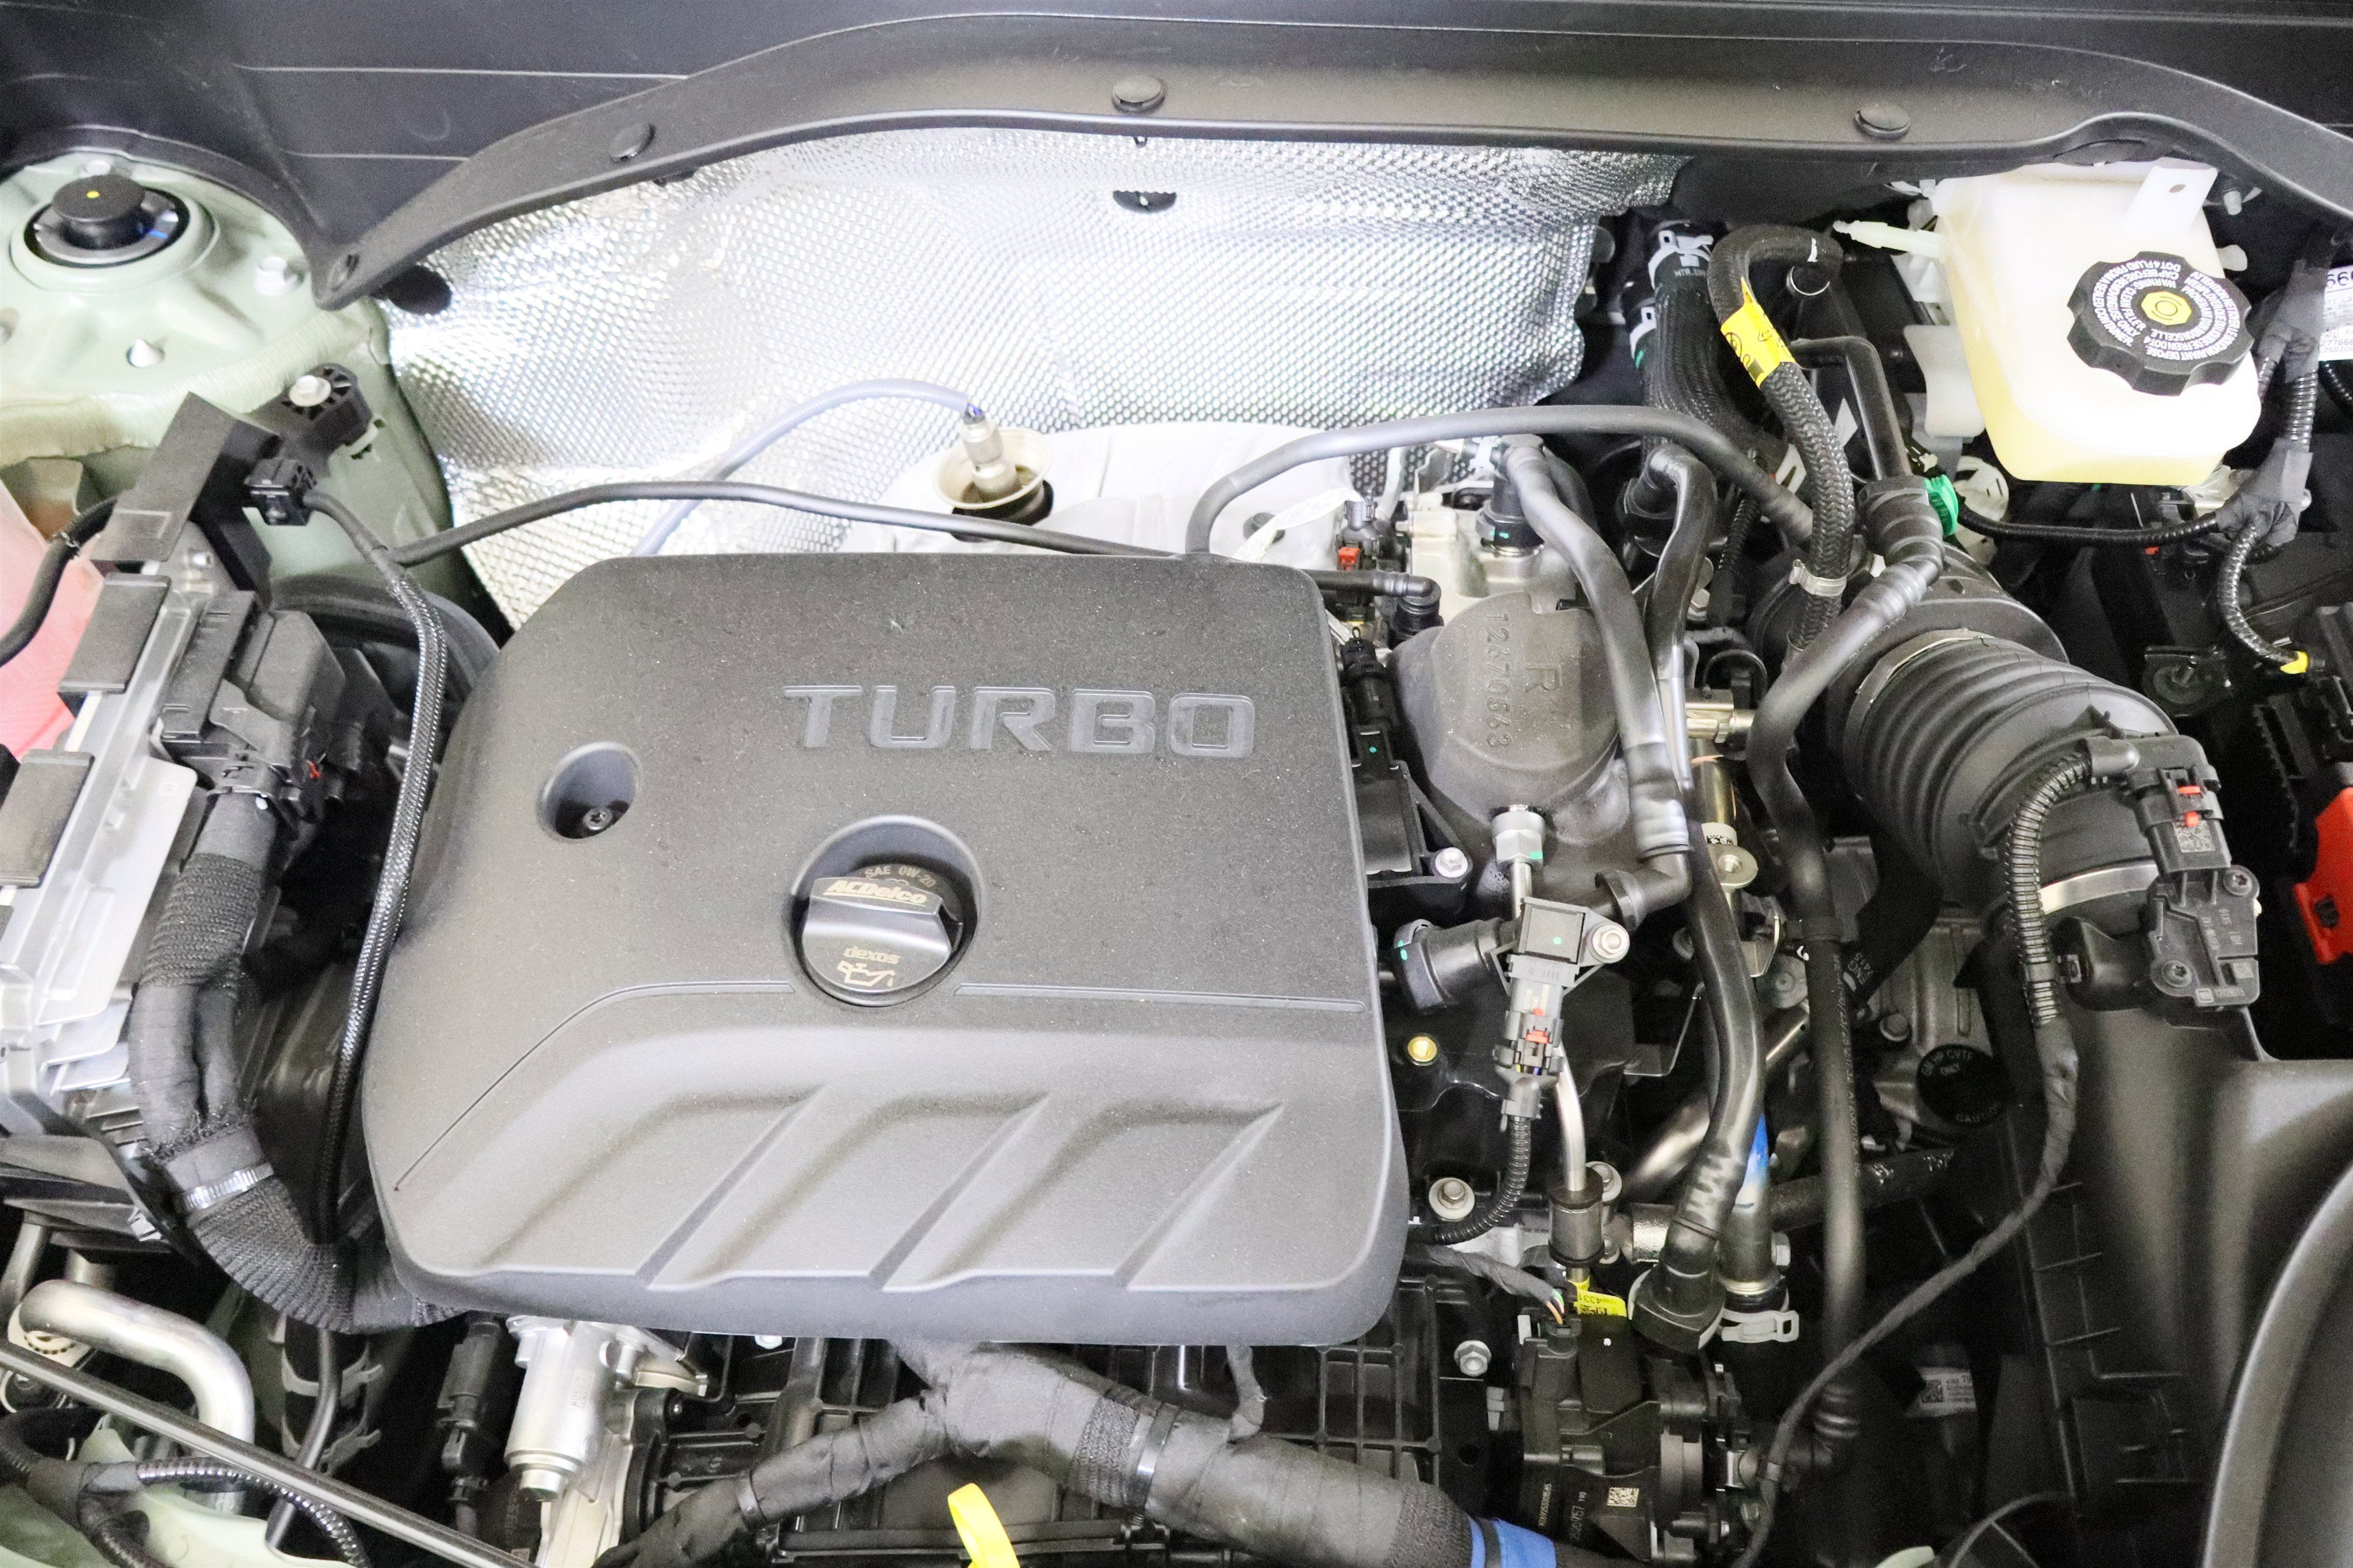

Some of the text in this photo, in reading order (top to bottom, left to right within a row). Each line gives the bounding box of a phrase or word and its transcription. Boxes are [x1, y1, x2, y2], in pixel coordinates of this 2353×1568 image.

[2126, 260, 2154, 271] FLUID
[2153, 260, 2161, 269] 4
[2161, 261, 2181, 272] DOT
[2103, 265, 2128, 281] FROM
[2123, 268, 2158, 283] BEFORE
[2158, 269, 2179, 280] CAP
[2092, 281, 2108, 307] SEALED
[2120, 287, 2136, 307] CLEAN
[2107, 307, 2124, 321] USE
[2121, 308, 2146, 332] FILLER
[2117, 319, 2140, 338] ONLY
[2225, 327, 2238, 337] LE
[2143, 335, 2152, 345] 4
[2148, 338, 2167, 349] DOT
[2167, 341, 2193, 352] FREIN
[2189, 339, 2204, 349] DE
[2203, 333, 2235, 356] BOUCHON
[2178, 349, 2208, 360] AVANT
[1525, 664, 1564, 693] R
[782, 685, 1255, 758] TURBO
[865, 866, 891, 878] SAE
[899, 867, 936, 887] 0W-20
[825, 880, 927, 905] ACDelco
[844, 946, 900, 964] dexos
[1848, 960, 1867, 985] ENG
[1579, 1293, 1602, 1304] 4331
